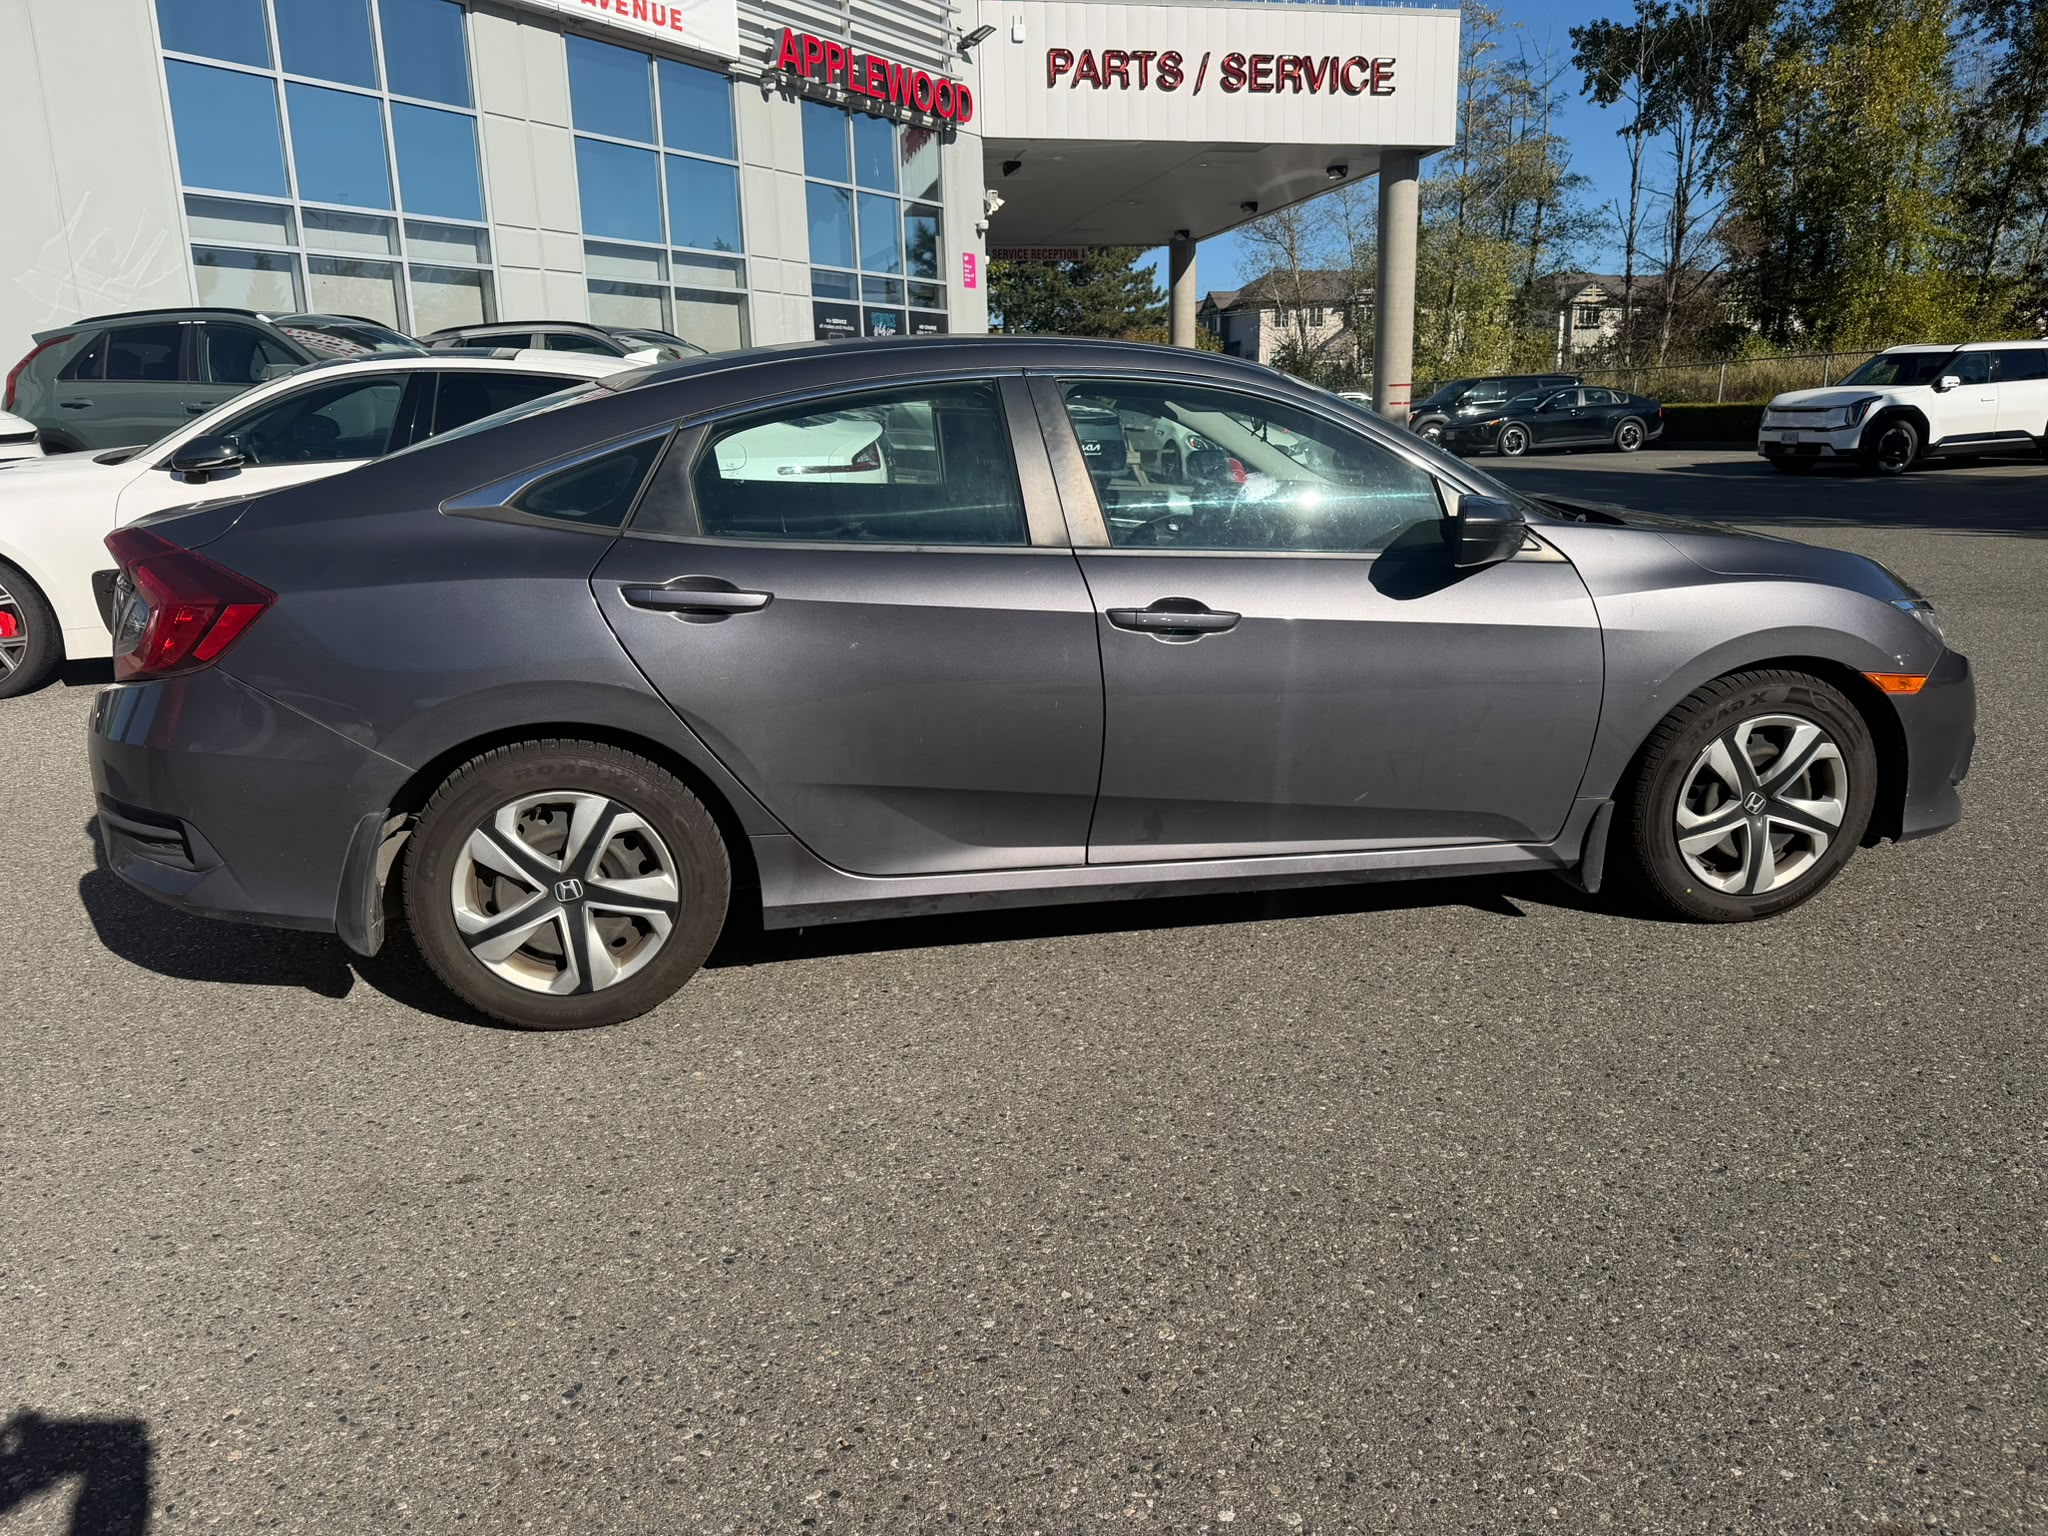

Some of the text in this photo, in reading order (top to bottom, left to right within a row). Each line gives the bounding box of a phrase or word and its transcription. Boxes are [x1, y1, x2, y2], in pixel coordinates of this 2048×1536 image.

[773, 26, 973, 123] APPLEWOOD
[1047, 48, 1396, 97] PARTS / SERVICE
[992, 248, 1079, 260] SERVICE RECEPTION
